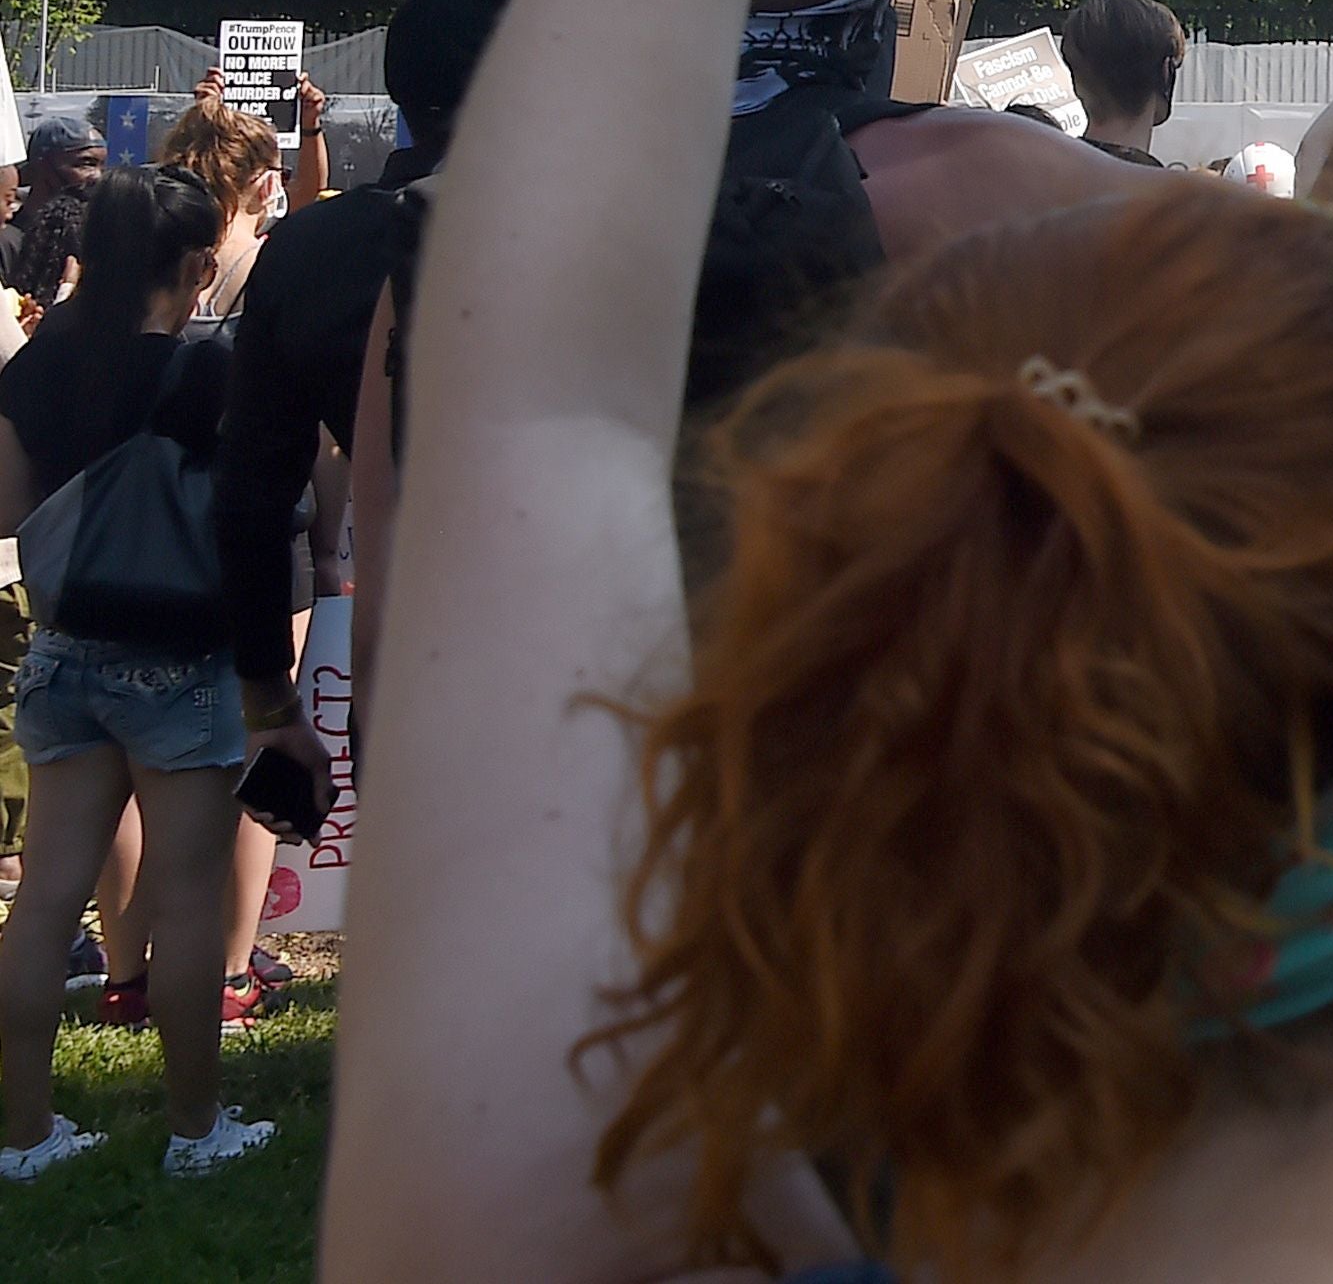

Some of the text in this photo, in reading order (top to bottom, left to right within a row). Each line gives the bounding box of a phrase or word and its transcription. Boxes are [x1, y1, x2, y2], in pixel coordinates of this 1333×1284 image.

[228, 24, 296, 35] #TrumpPence
[228, 35, 296, 51] OUTNOW
[225, 56, 286, 70] NO MORE
[973, 47, 1037, 78] Fascism
[224, 72, 272, 86] POLICE
[977, 70, 1031, 100] Cannot
[224, 87, 281, 100] MURDER
